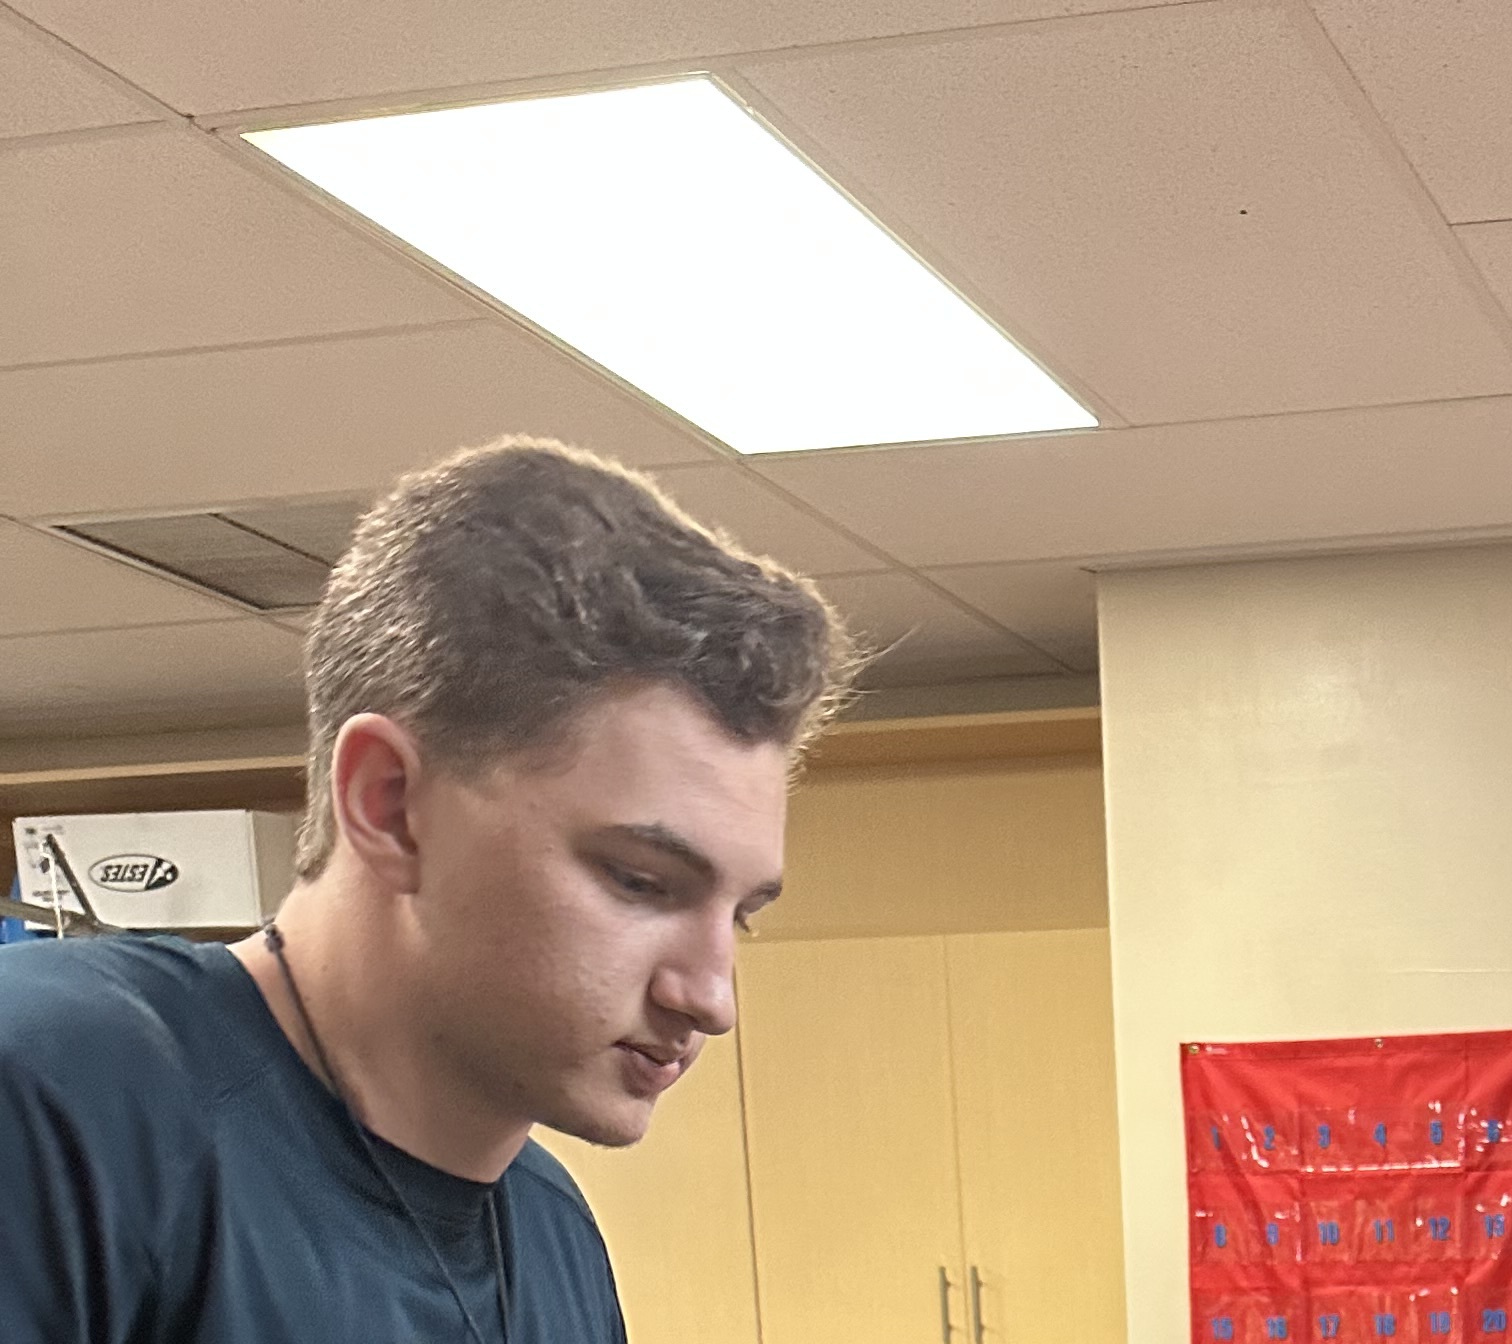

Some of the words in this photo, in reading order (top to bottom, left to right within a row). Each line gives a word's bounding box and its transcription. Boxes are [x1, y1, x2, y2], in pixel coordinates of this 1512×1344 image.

[99, 863, 150, 884] ESTES
[1263, 1125, 1275, 1150] 2
[1317, 1124, 1331, 1148] 3
[1373, 1122, 1387, 1146] 4
[1429, 1120, 1443, 1145] 5
[1317, 1221, 1340, 1245] 10
[1373, 1219, 1395, 1243] 11
[1428, 1216, 1450, 1240] 12
[1484, 1214, 1505, 1238] 13
[1211, 1316, 1234, 1341] 15
[1266, 1316, 1288, 1340] 16
[1318, 1314, 1340, 1338] 17
[1374, 1313, 1396, 1337] 18
[1429, 1311, 1451, 1335] 19
[1482, 1309, 1507, 1333] 20
